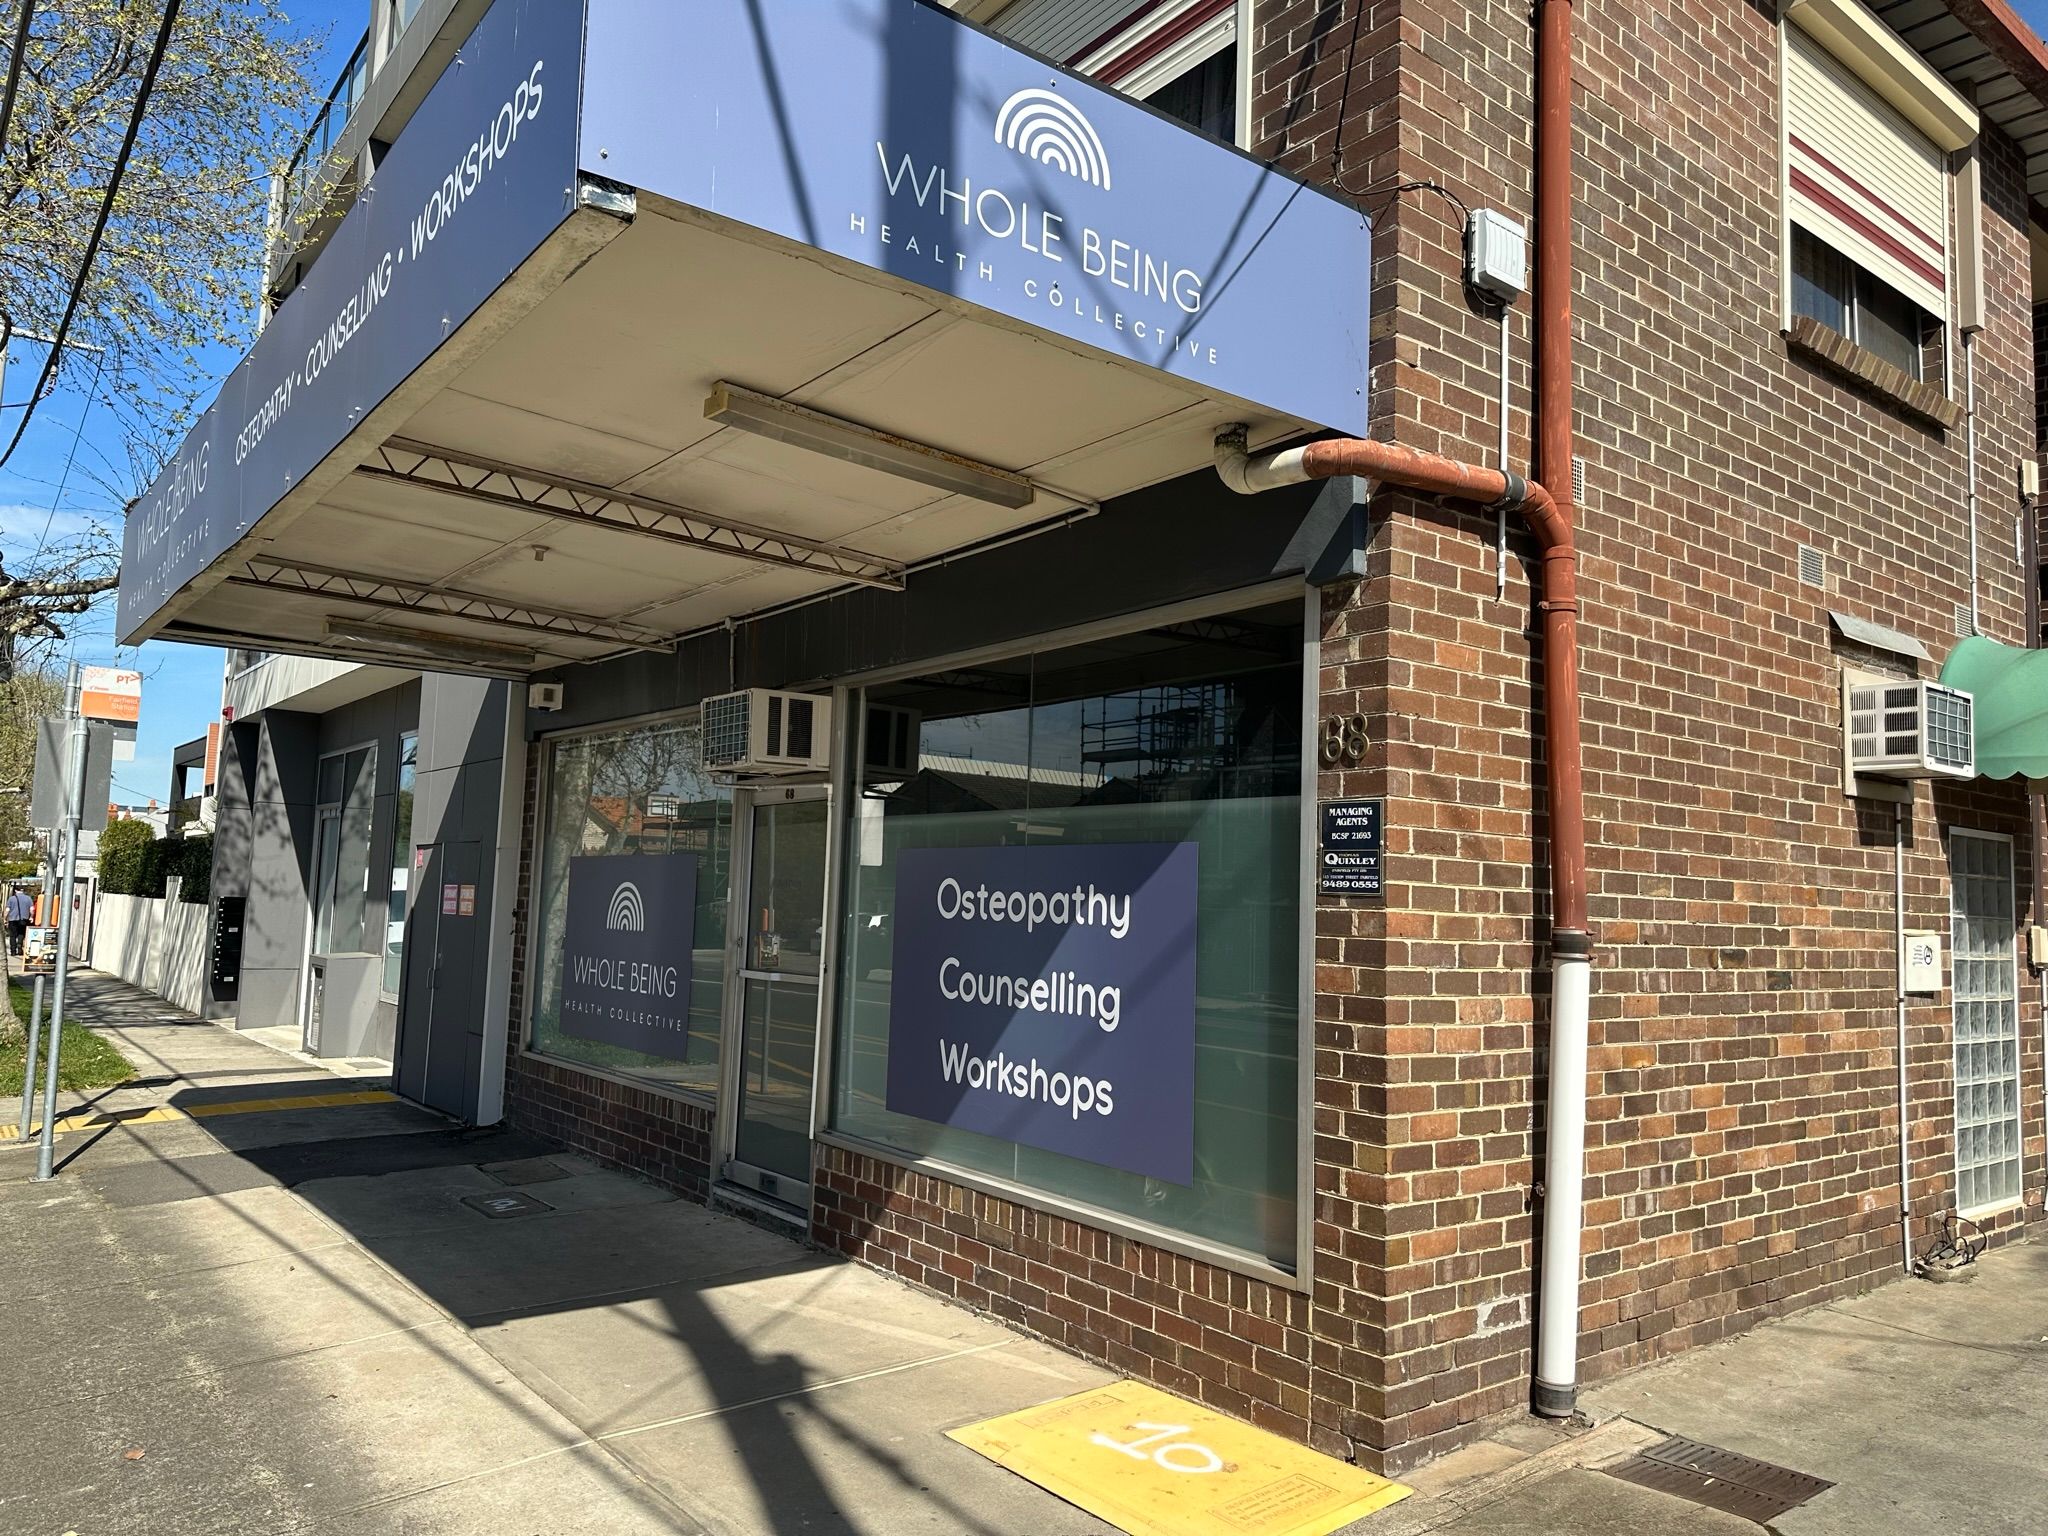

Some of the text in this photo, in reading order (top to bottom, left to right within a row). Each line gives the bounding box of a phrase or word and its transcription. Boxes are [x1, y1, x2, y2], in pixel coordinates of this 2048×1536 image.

[877, 141, 1202, 313] WHOLE BEING
[235, 60, 543, 465] OSTEOPATHY COUNSELLING WORKSHOPS
[850, 212, 1217, 364] HEALTH COLLECTIVE
[137, 441, 210, 563] WHOLE BEING
[129, 518, 209, 612] HEALTH COLLECTIVE
[111, 702, 137, 711] Station
[1322, 713, 1370, 763] 68
[1328, 807, 1372, 816] MANAGING
[1336, 817, 1368, 826] AGENTS
[1322, 880, 1379, 889] 9489 0555
[1324, 853, 1377, 865] QUIXLEY
[937, 877, 1130, 939] Osteopathy
[574, 955, 677, 998] WHOLE BEING
[939, 957, 1121, 1032] Counselling
[565, 1000, 681, 1032] HEALTH COLLECTIVE
[939, 1038, 1114, 1120] Workshops
